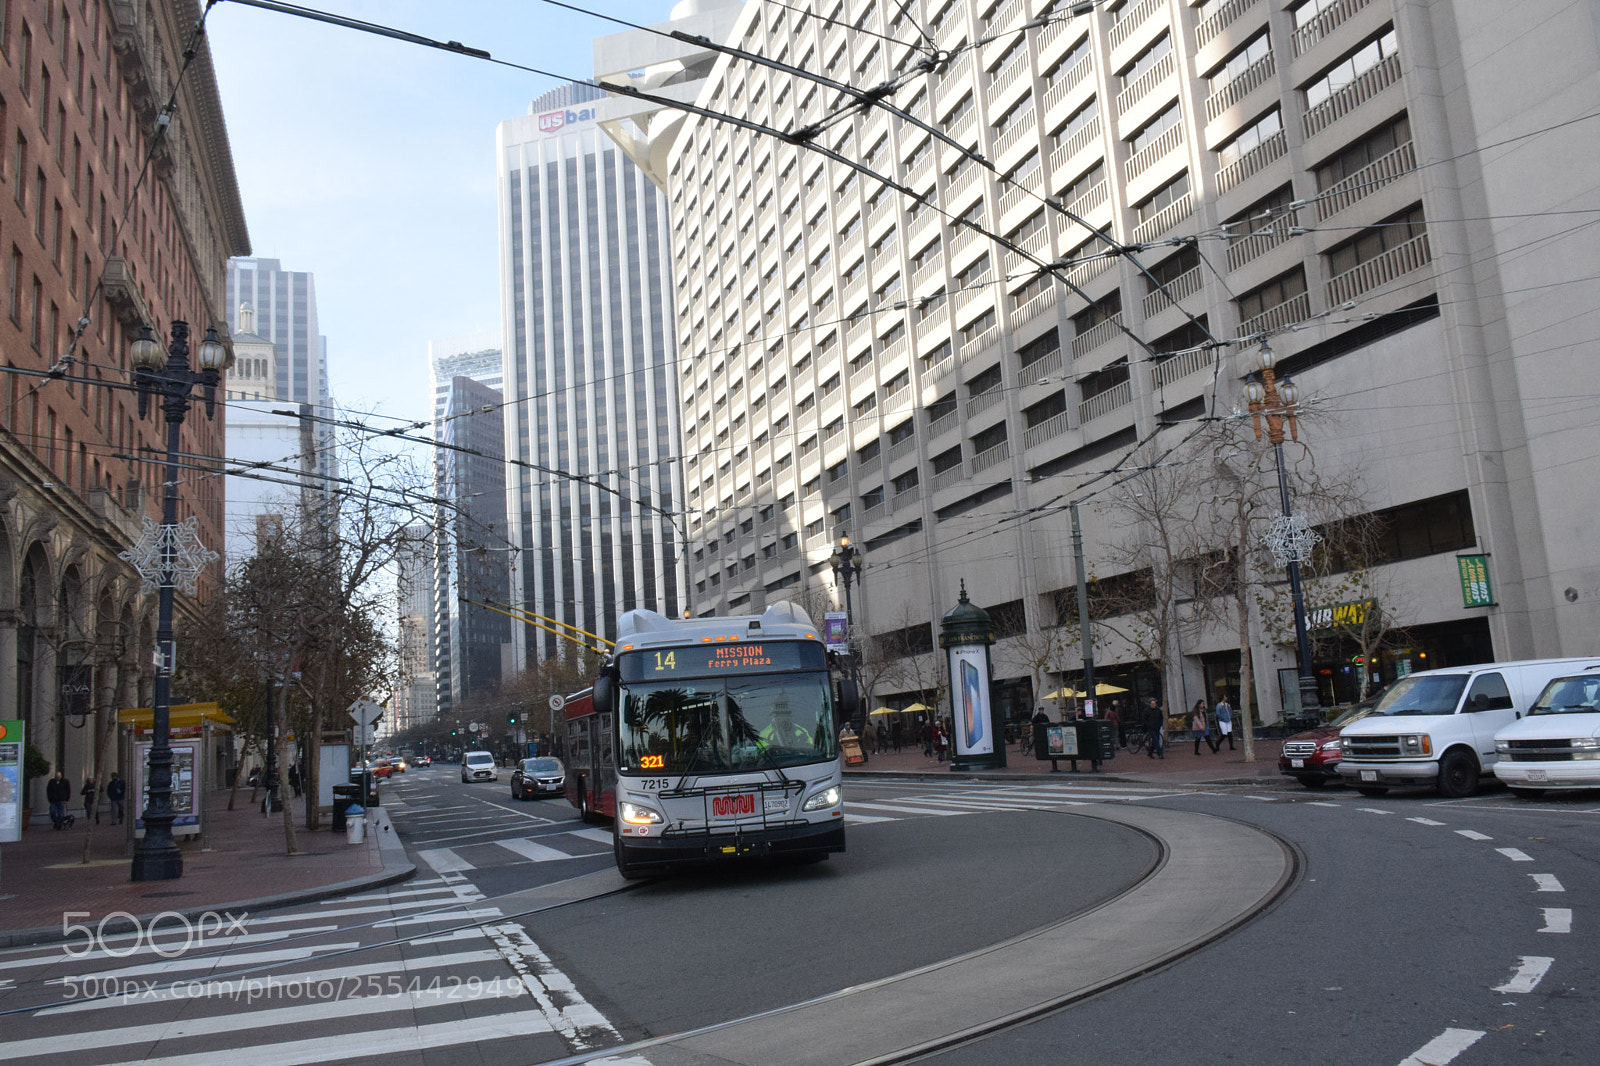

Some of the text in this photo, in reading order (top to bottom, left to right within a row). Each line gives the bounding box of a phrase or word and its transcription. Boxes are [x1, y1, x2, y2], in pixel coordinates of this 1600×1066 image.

[1467, 559, 1481, 603] SUBWAY
[1475, 558, 1489, 602] SUBWAY
[716, 645, 763, 659] MISSION
[654, 651, 676, 671] 14
[708, 657, 771, 668] Ferry Plaza
[640, 755, 664, 769] 321
[641, 779, 669, 790] 7215
